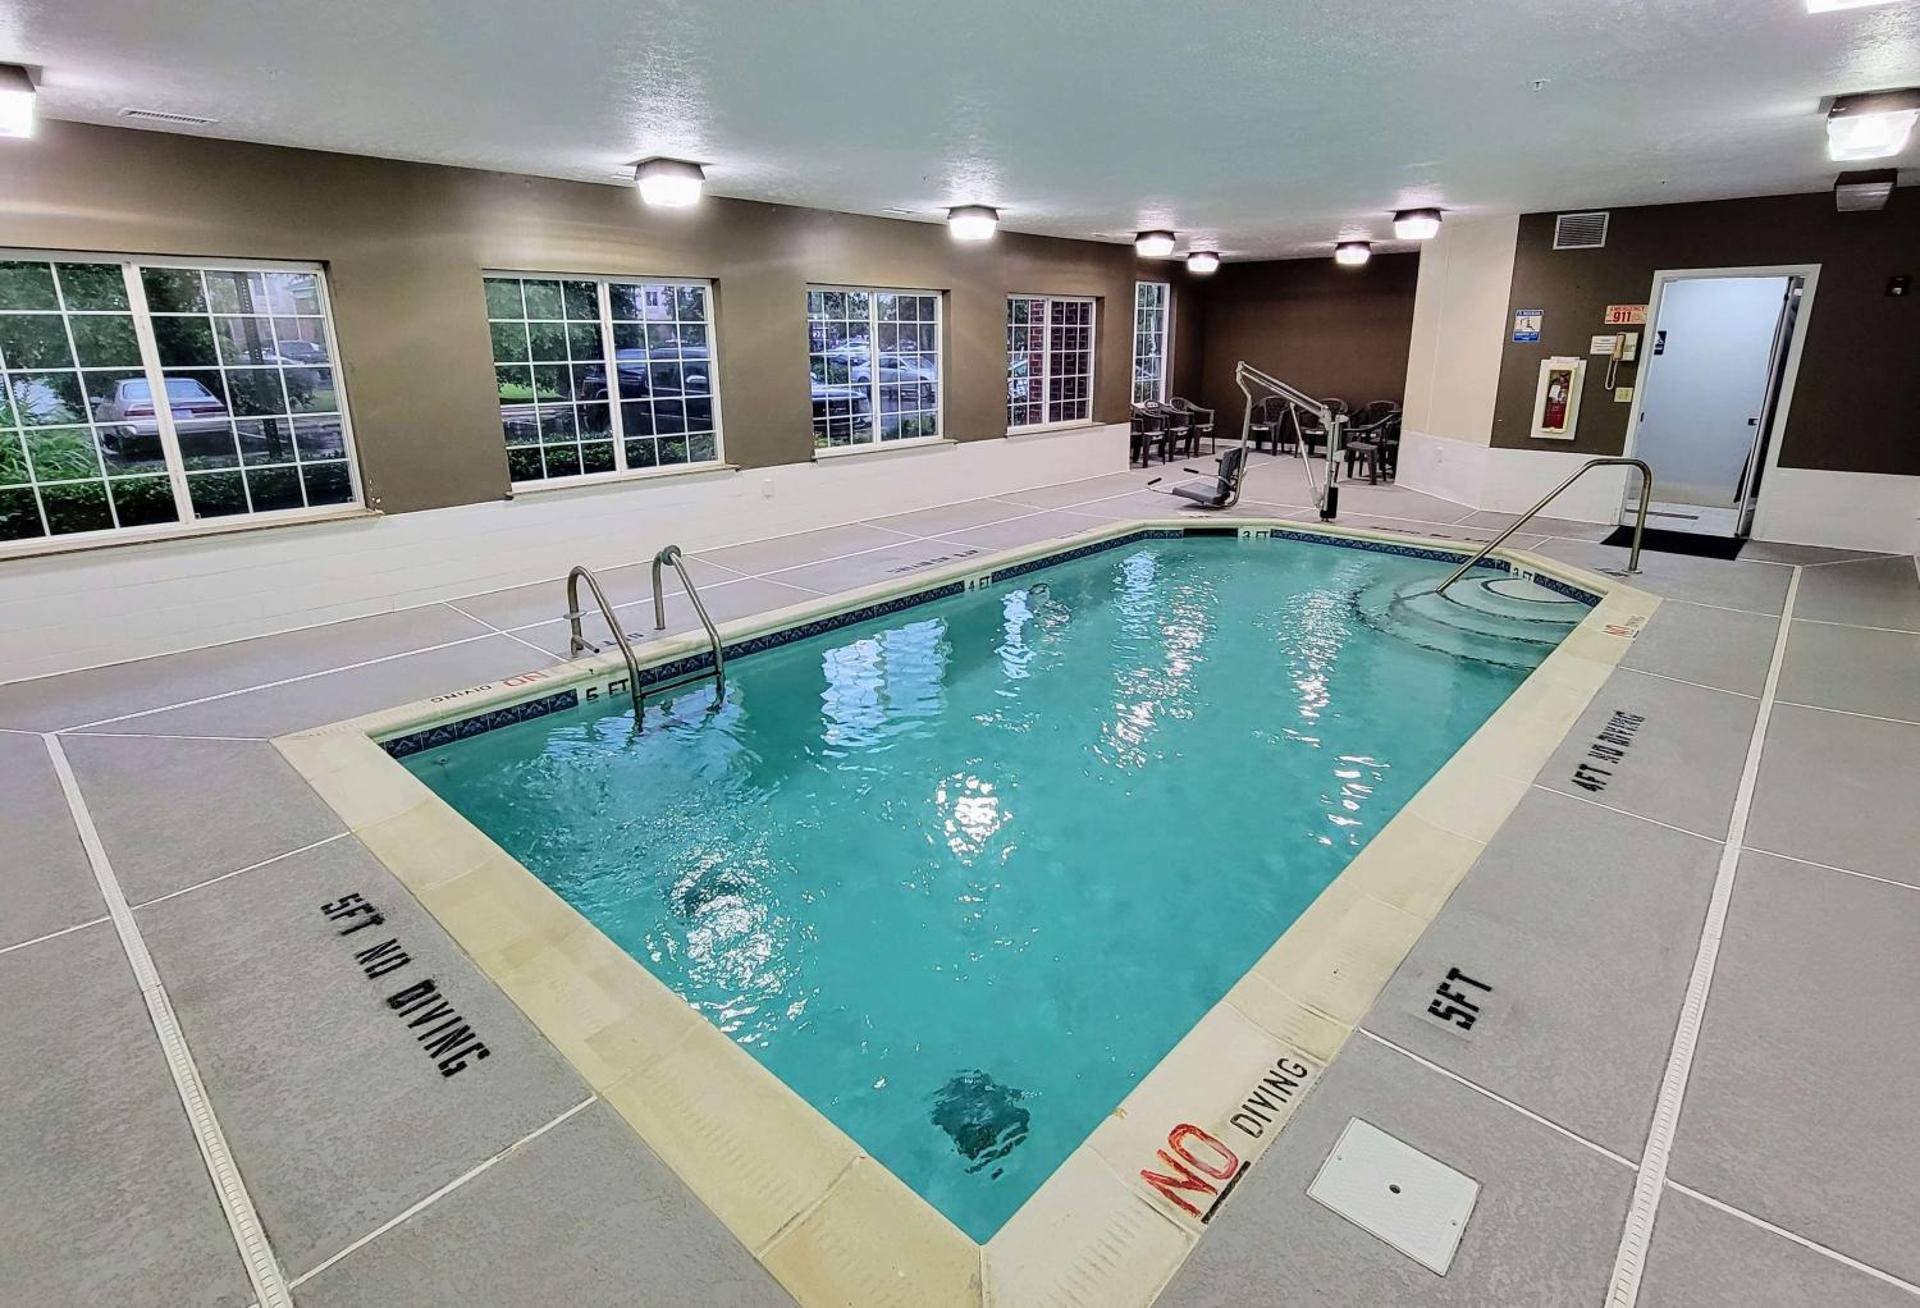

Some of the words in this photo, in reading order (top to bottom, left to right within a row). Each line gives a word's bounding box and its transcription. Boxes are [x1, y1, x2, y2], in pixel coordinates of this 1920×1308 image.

[1613, 311, 1632, 323] 911
[430, 684, 492, 703] DIVING
[586, 686, 598, 701] 5
[608, 678, 629, 695] FT
[1596, 710, 1646, 747] DIVING
[1587, 744, 1624, 764] NO
[1571, 763, 1612, 791] 4FT
[320, 893, 385, 936] 5FT
[354, 938, 411, 980] NO
[386, 978, 491, 1079] DIVING
[1427, 967, 1493, 1031] 5FT
[1140, 1123, 1239, 1216] NO
[1229, 1058, 1308, 1139] DIVING
